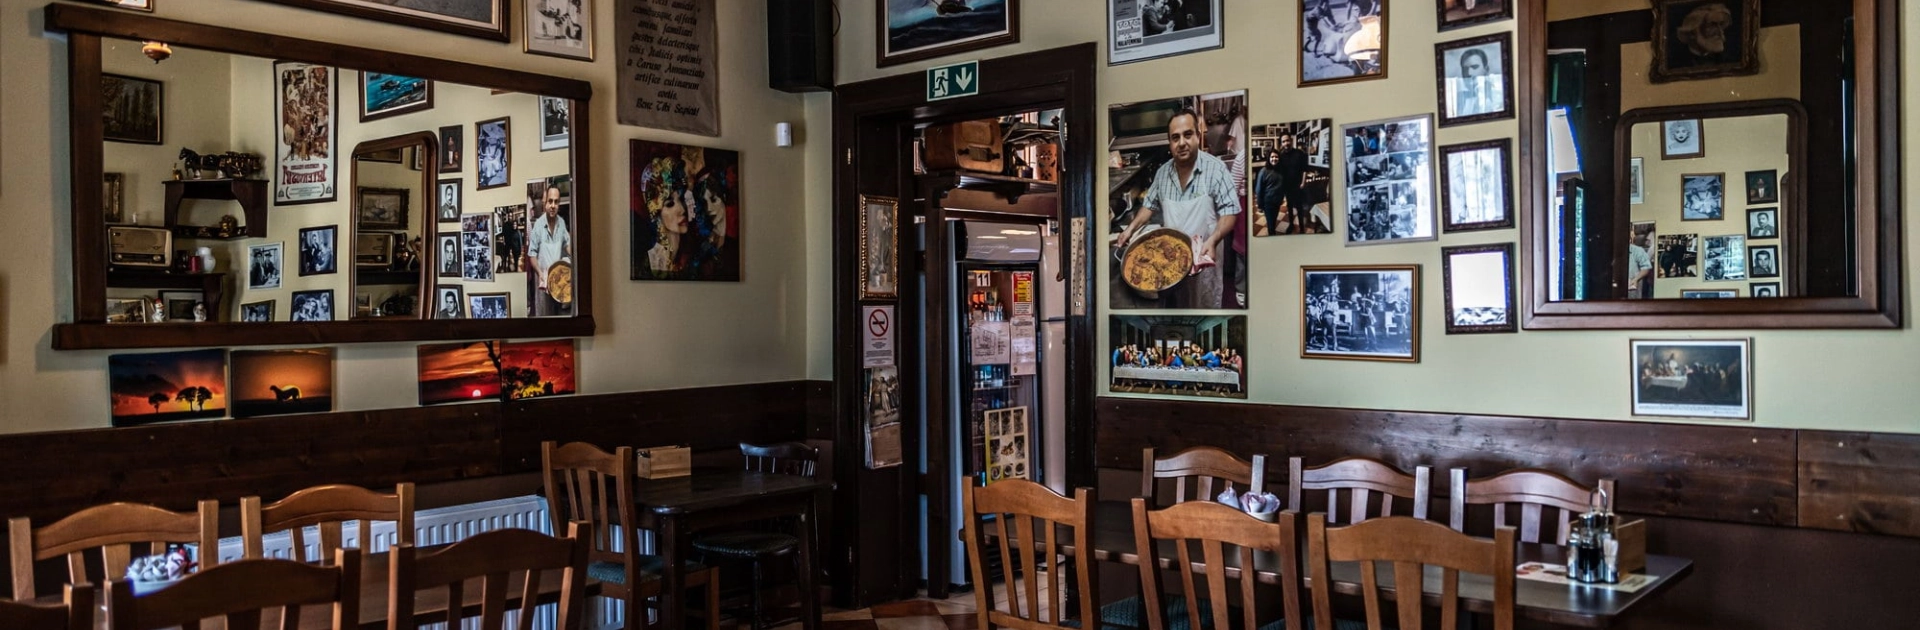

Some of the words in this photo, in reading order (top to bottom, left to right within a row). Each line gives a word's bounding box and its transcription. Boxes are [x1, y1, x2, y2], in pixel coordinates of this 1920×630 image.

[627, 58, 633, 66] a
[636, 57, 661, 71] Caruso
[634, 72, 661, 85] artifice
[636, 97, 653, 110] Bene
[656, 100, 671, 112] Tibi
[977, 273, 989, 286] 11
